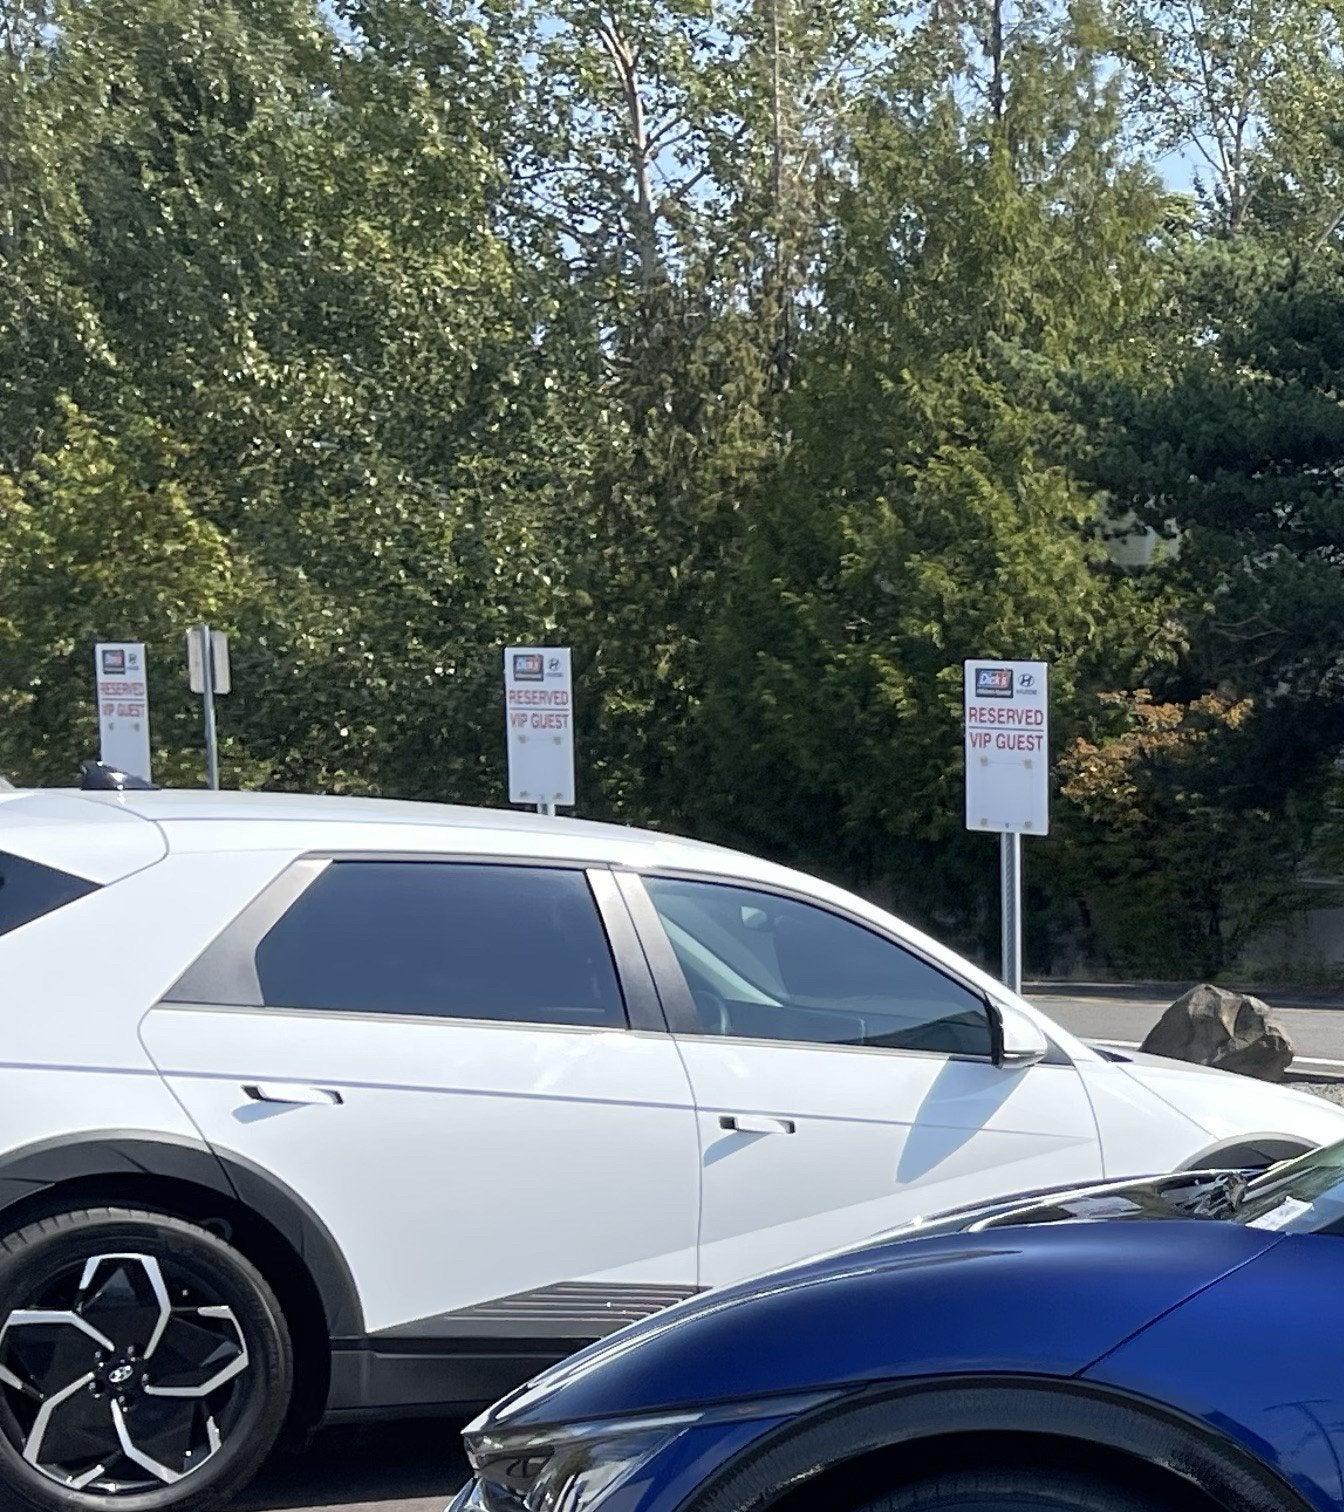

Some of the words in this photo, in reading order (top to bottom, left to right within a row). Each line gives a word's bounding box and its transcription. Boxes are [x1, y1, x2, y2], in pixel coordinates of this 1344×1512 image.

[509, 689, 569, 706] RESERVED
[531, 713, 569, 730] GUEST
[968, 707, 1044, 726] RESERVED
[969, 732, 992, 748] VIP
[996, 733, 1044, 752] GUEST
